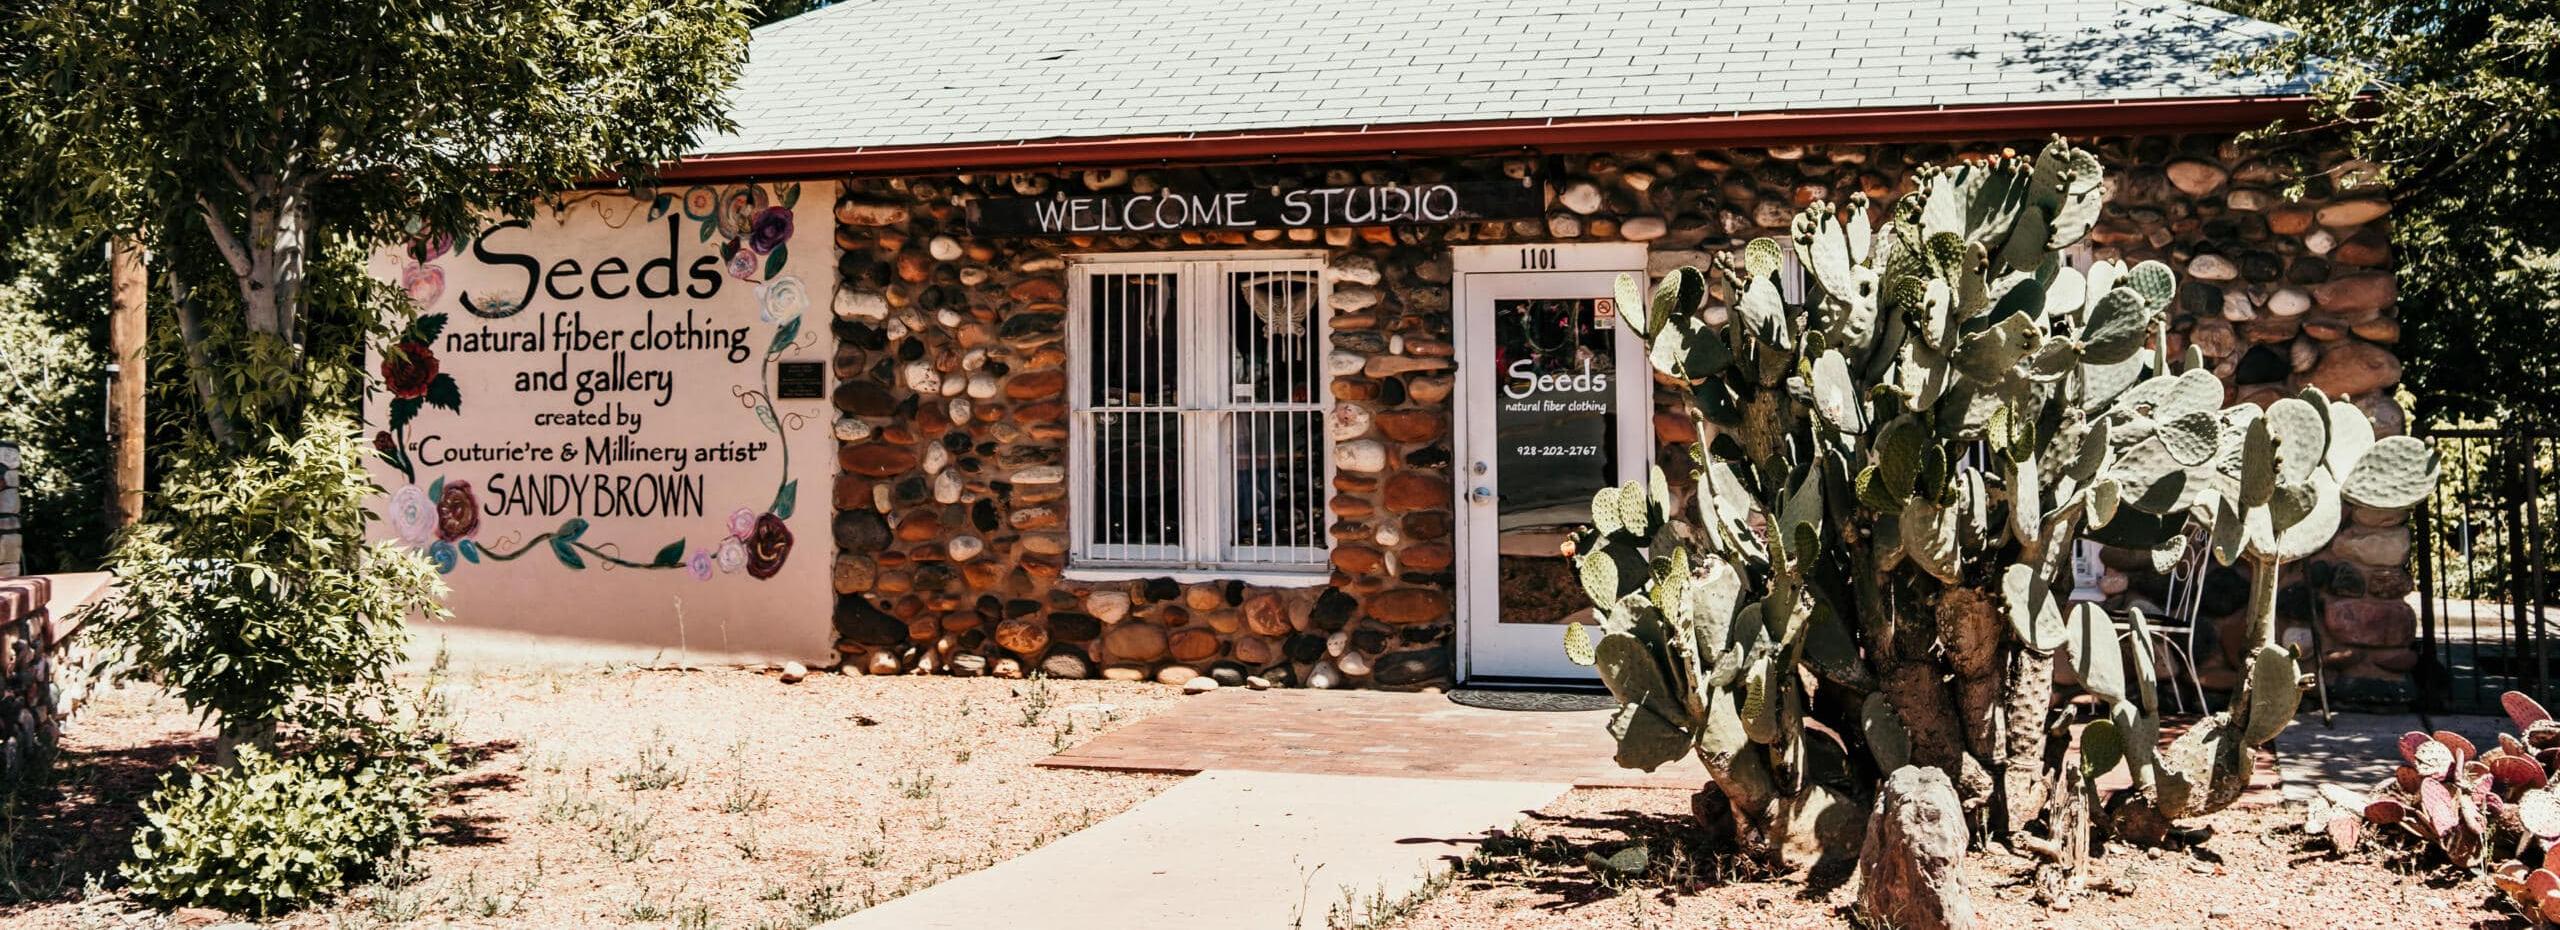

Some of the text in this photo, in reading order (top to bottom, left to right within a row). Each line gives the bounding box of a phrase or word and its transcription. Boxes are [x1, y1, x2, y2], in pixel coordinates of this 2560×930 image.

[1035, 184, 1459, 232] WELCOME STUDIO
[458, 212, 723, 319] Seeds
[1520, 248, 1557, 269] 1101
[446, 309, 750, 364] natural fiber clothing
[514, 351, 673, 406] and gallery
[1503, 358, 1607, 399] Seeds
[534, 402, 642, 433] created by
[1505, 400, 1607, 415] natural fiber clothing
[560, 447, 578, 464] &
[584, 436, 687, 471] Millinery
[1517, 446, 1597, 456] 928-202-2767
[484, 473, 704, 517] SANDY BROWN
